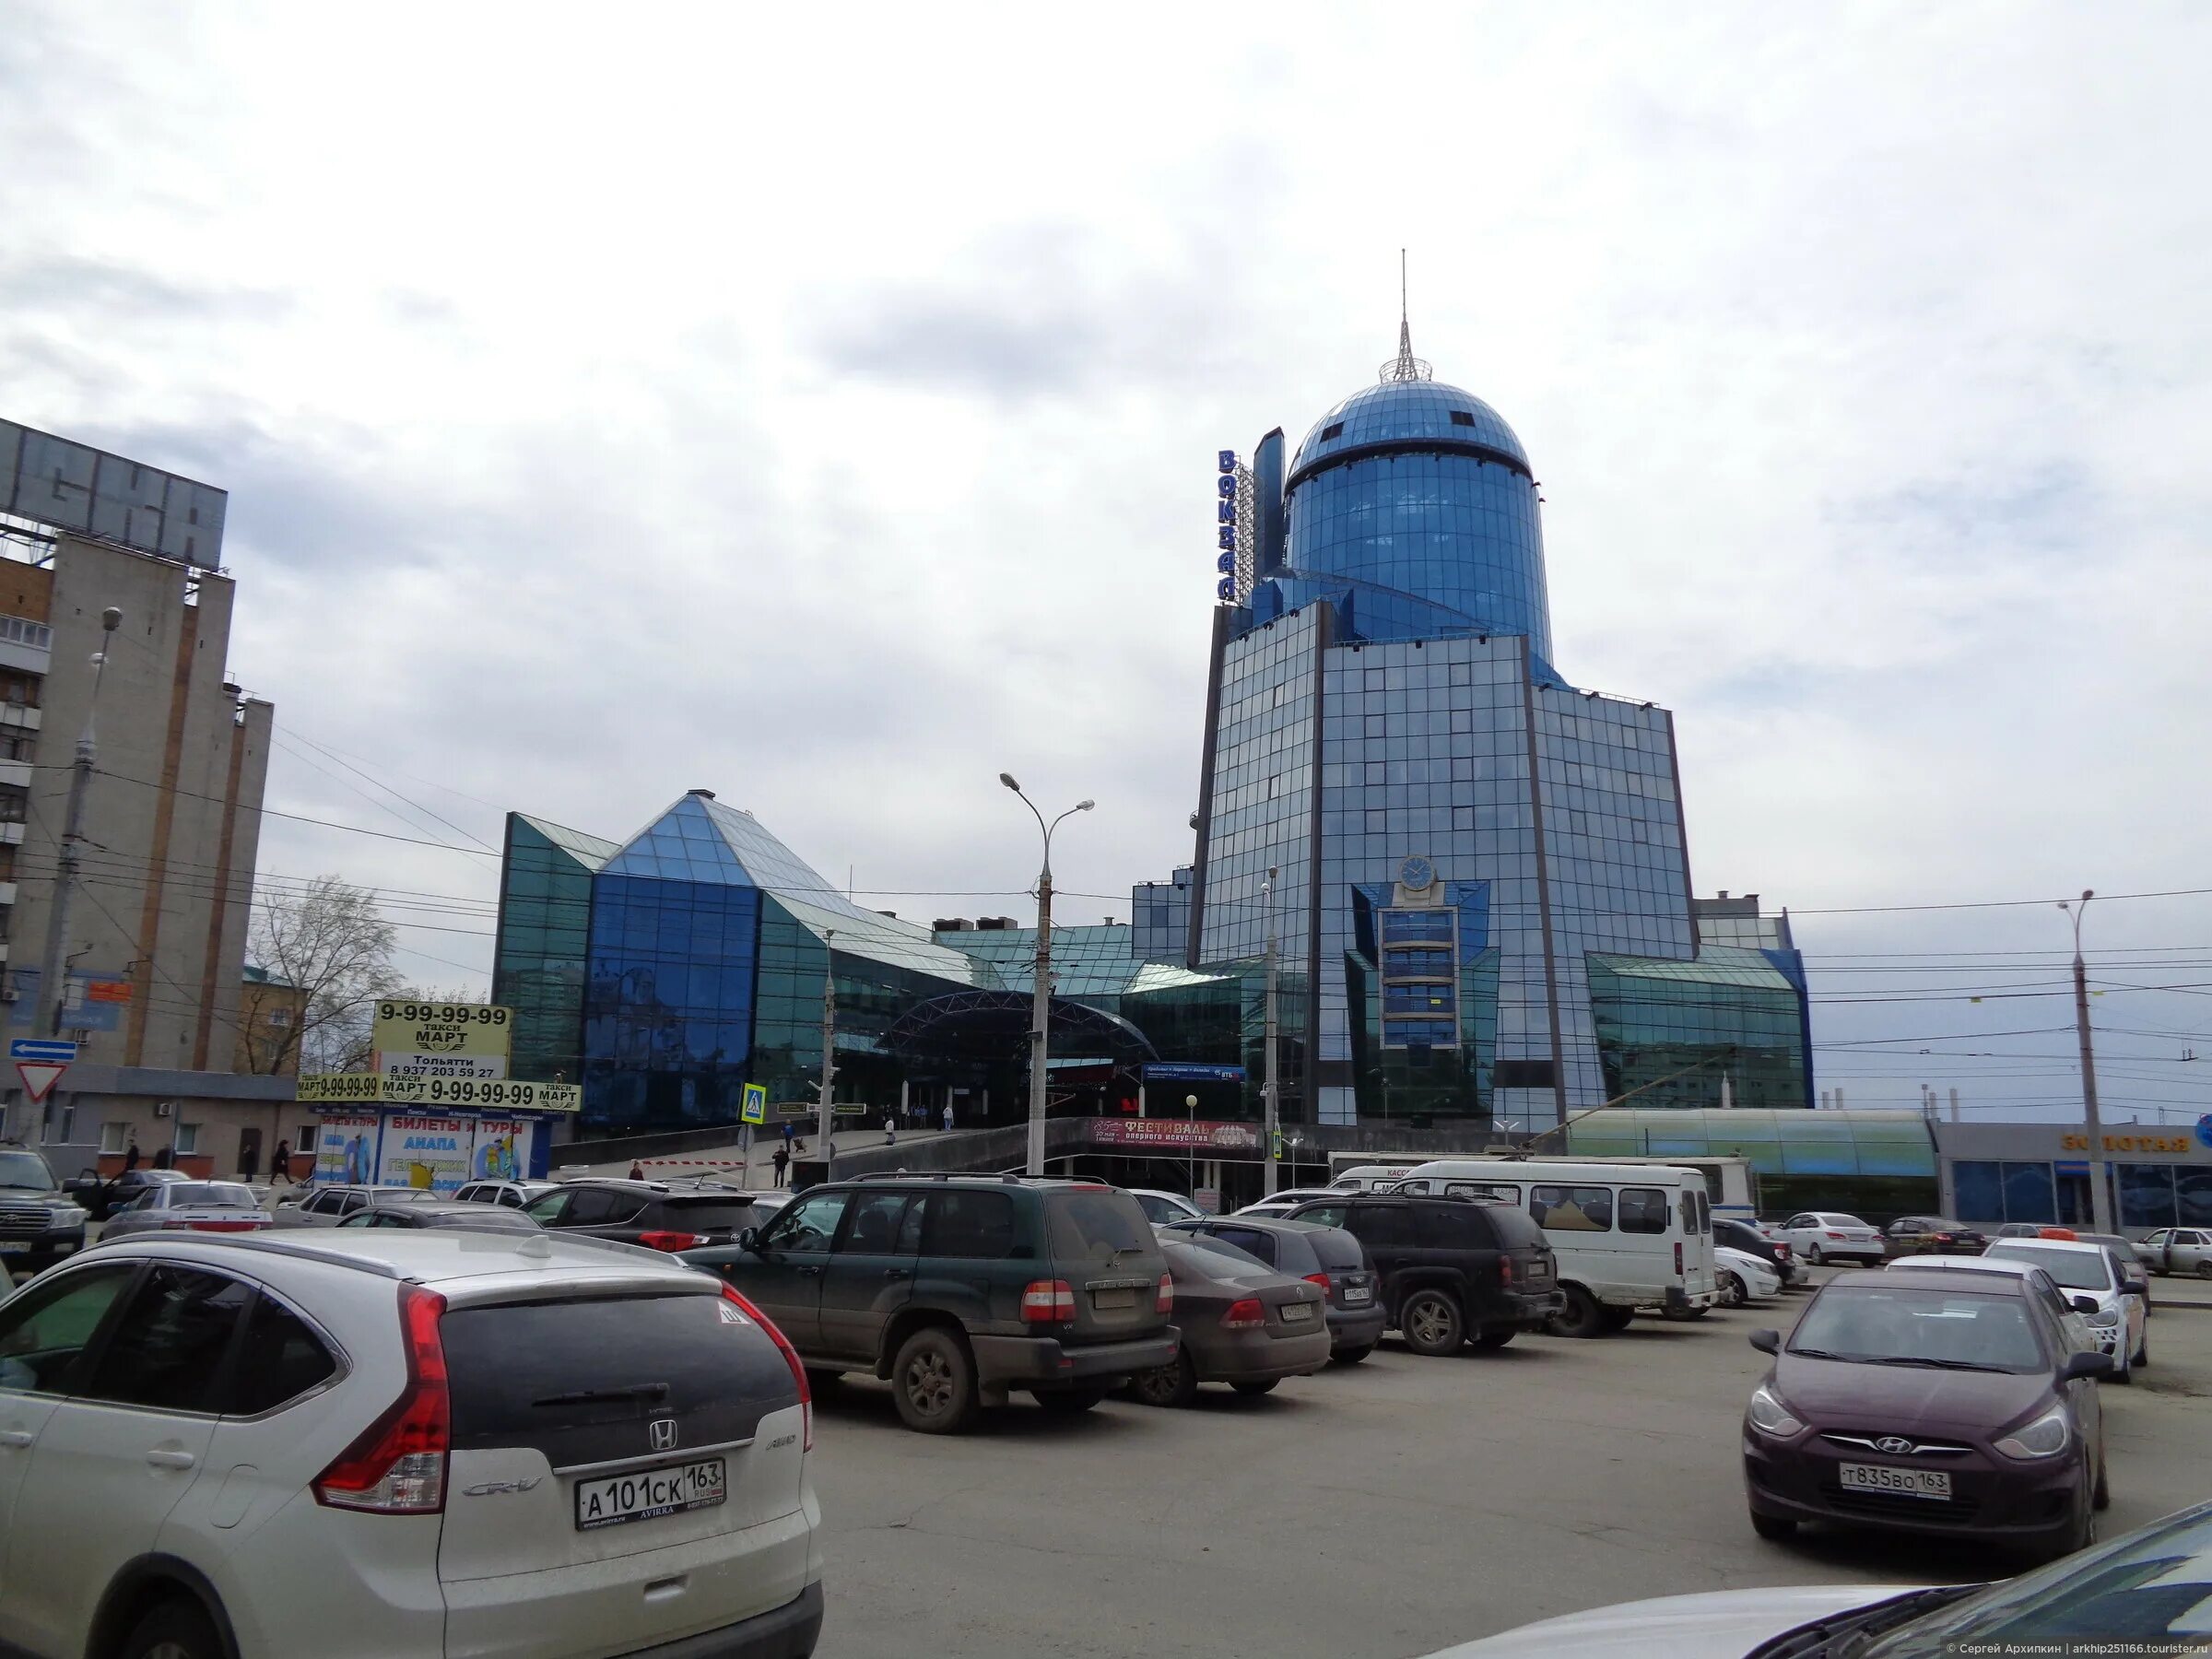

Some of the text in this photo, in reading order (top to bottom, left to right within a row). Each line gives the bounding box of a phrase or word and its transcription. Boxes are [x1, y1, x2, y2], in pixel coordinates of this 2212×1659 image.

[1218, 450, 1237, 601] ВОКЗАЛ
[381, 1004, 507, 1025] 9-99-99-99
[423, 1023, 461, 1032] такси
[416, 1031, 468, 1042] МАРТ
[414, 1055, 474, 1066] Тольятти
[389, 1074, 420, 1082] такси
[390, 1065, 494, 1078] 8 937 203 59 27
[298, 1081, 321, 1091] МАРТ
[320, 1077, 377, 1097] 9-99-99-99
[382, 1081, 427, 1093] МАРТ
[430, 1080, 534, 1105] 9-99-99-99
[539, 1091, 577, 1101] МАРТ
[392, 1116, 460, 1132] БИЛЕТЫ
[482, 1121, 522, 1134] ТУРЫ
[1125, 1122, 1209, 1135] ФЕСТИВАЛЬ
[404, 1136, 457, 1150] АНАПА
[1845, 1467, 1947, 1488] Т835ВО 163
[588, 1464, 720, 1517] А101СК 163
[694, 1488, 710, 1498] RUS
[641, 1505, 674, 1519] AVIRRA
